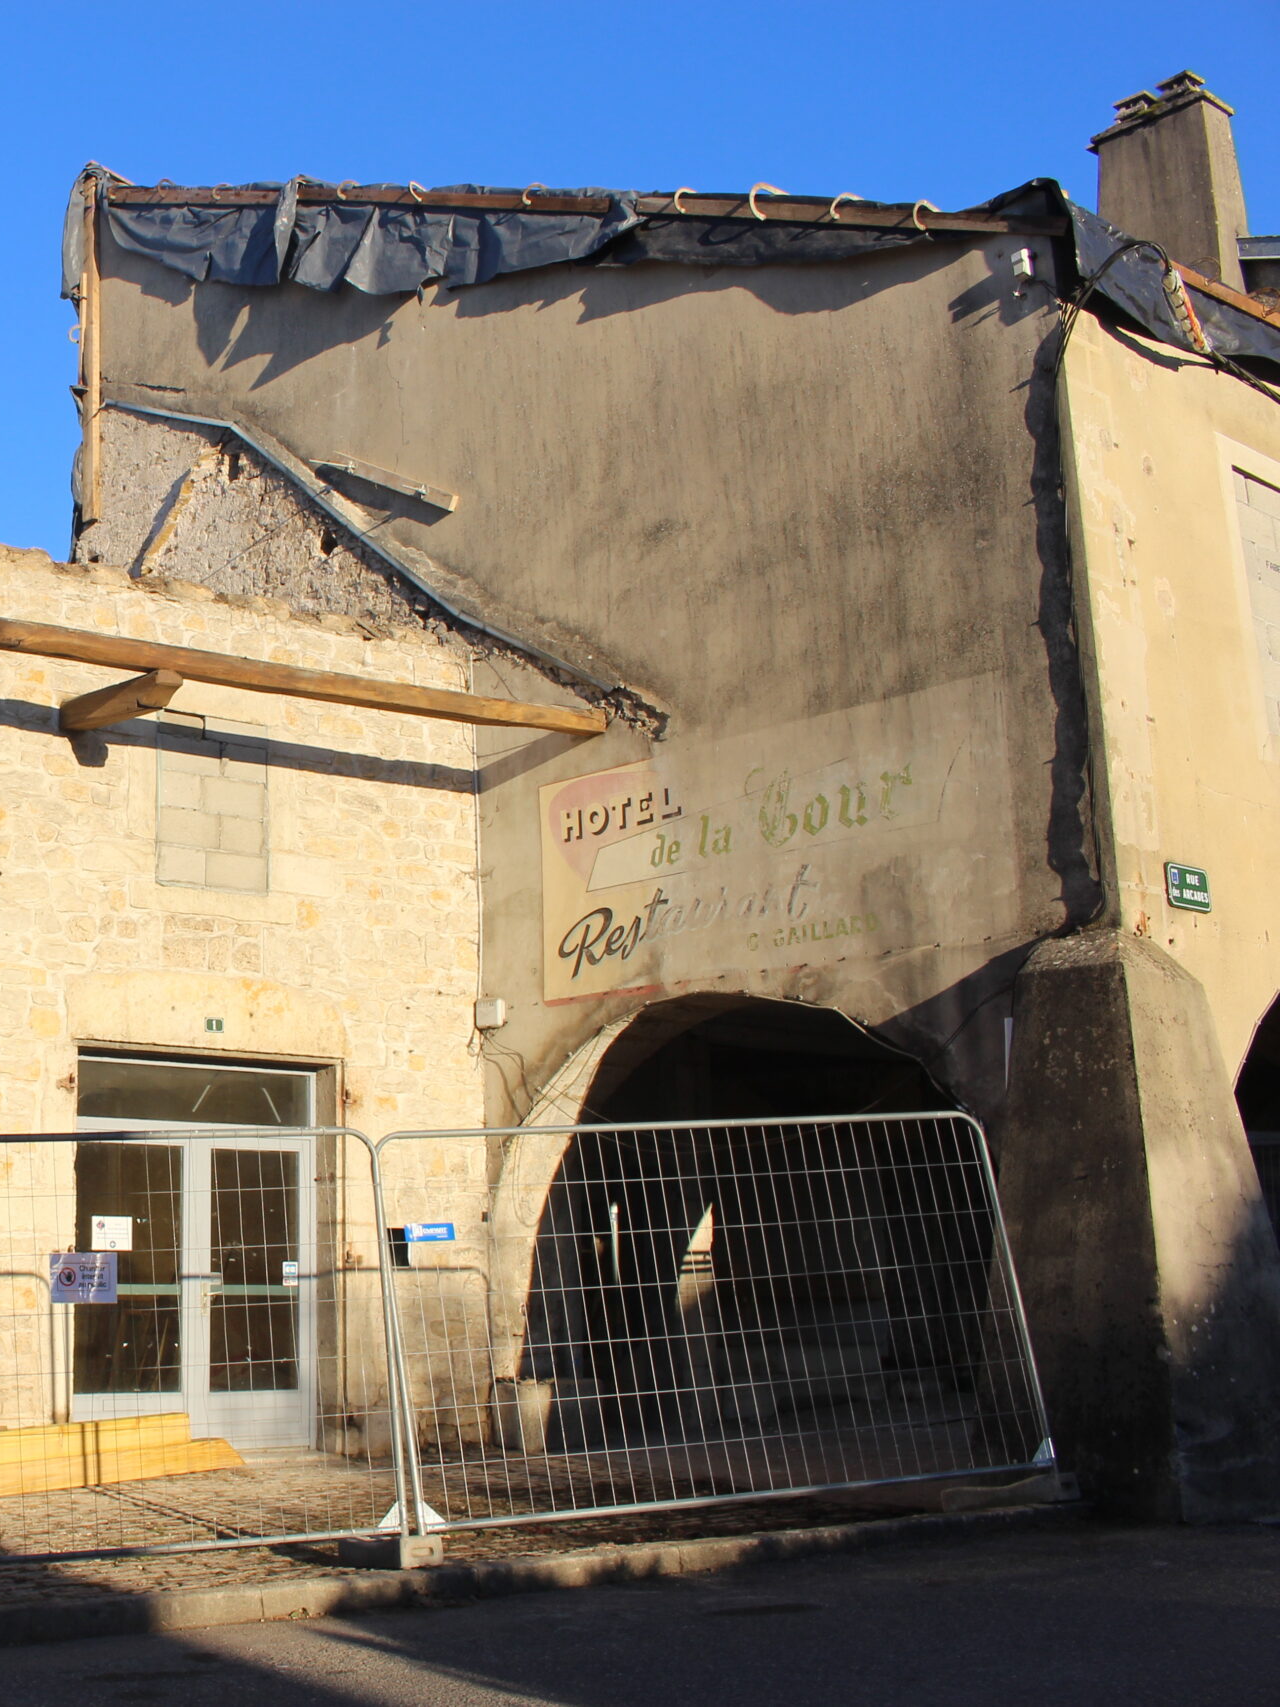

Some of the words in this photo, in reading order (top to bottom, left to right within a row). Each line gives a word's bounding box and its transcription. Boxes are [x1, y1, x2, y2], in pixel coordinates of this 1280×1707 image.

[560, 787, 683, 843] HOTEL
[650, 831, 681, 868] de
[697, 814, 733, 858] la
[1182, 888, 1209, 903] ARCADES
[1185, 873, 1200, 886] RUE
[557, 863, 820, 979] Restaurant
[773, 911, 878, 947] GAILLARD
